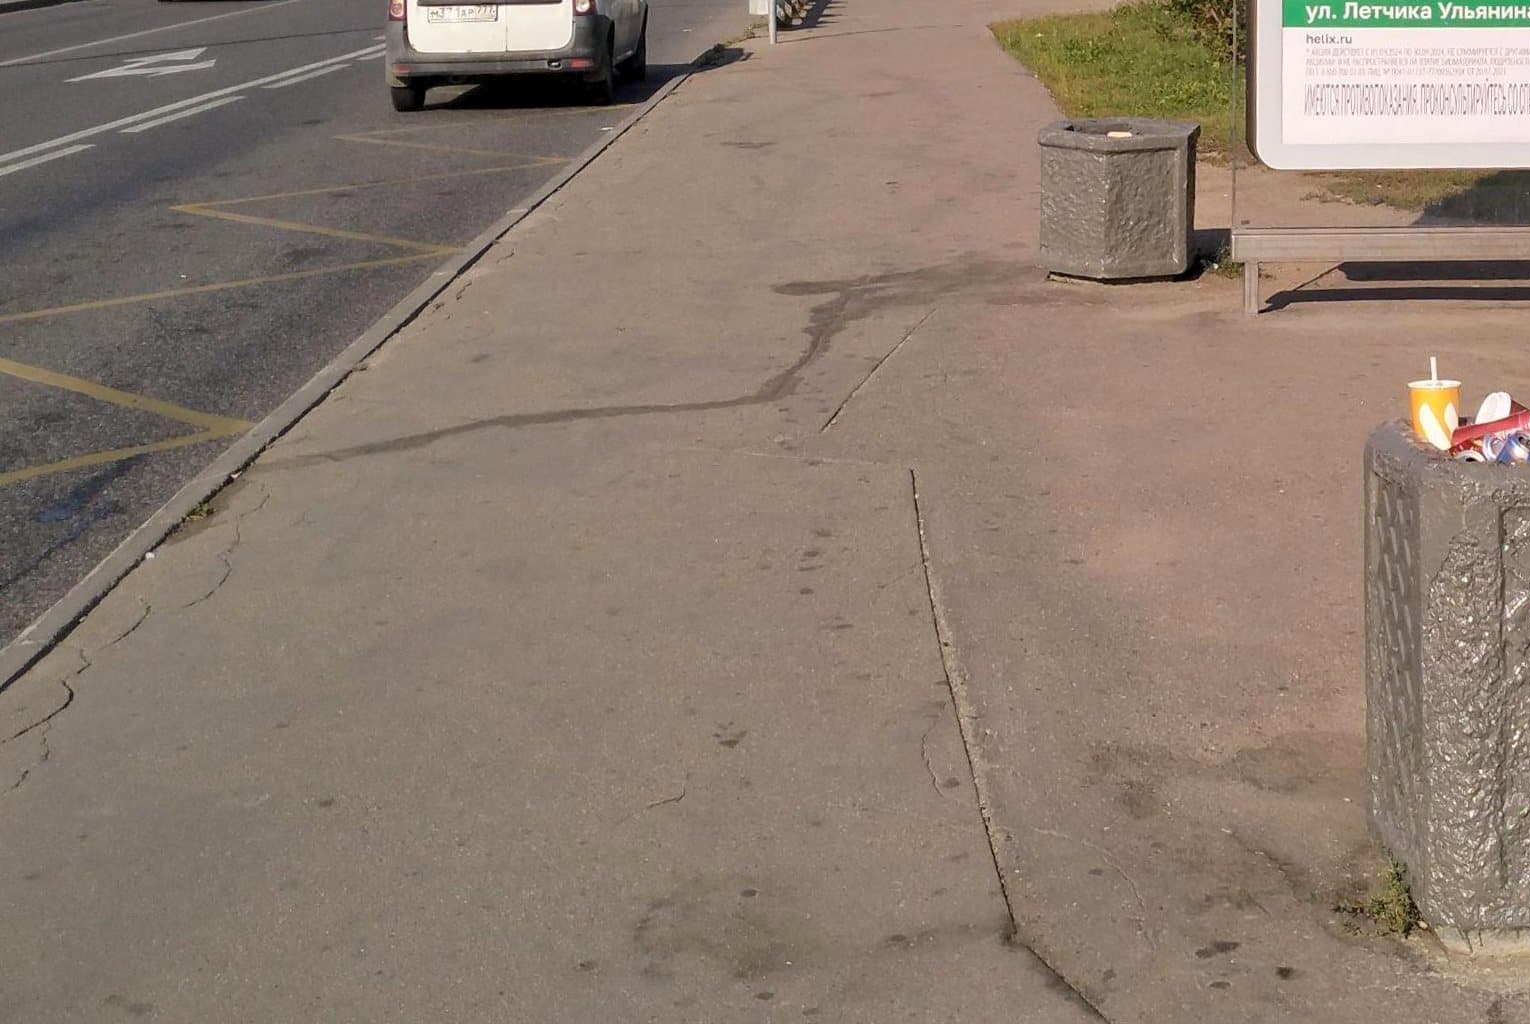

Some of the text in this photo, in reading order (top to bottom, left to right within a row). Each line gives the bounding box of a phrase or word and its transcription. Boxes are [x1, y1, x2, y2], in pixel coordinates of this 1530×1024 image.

[1305, 5, 1337, 24] ул.
[1342, 2, 1433, 20] Летчика
[1305, 33, 1353, 45] helix.ru
